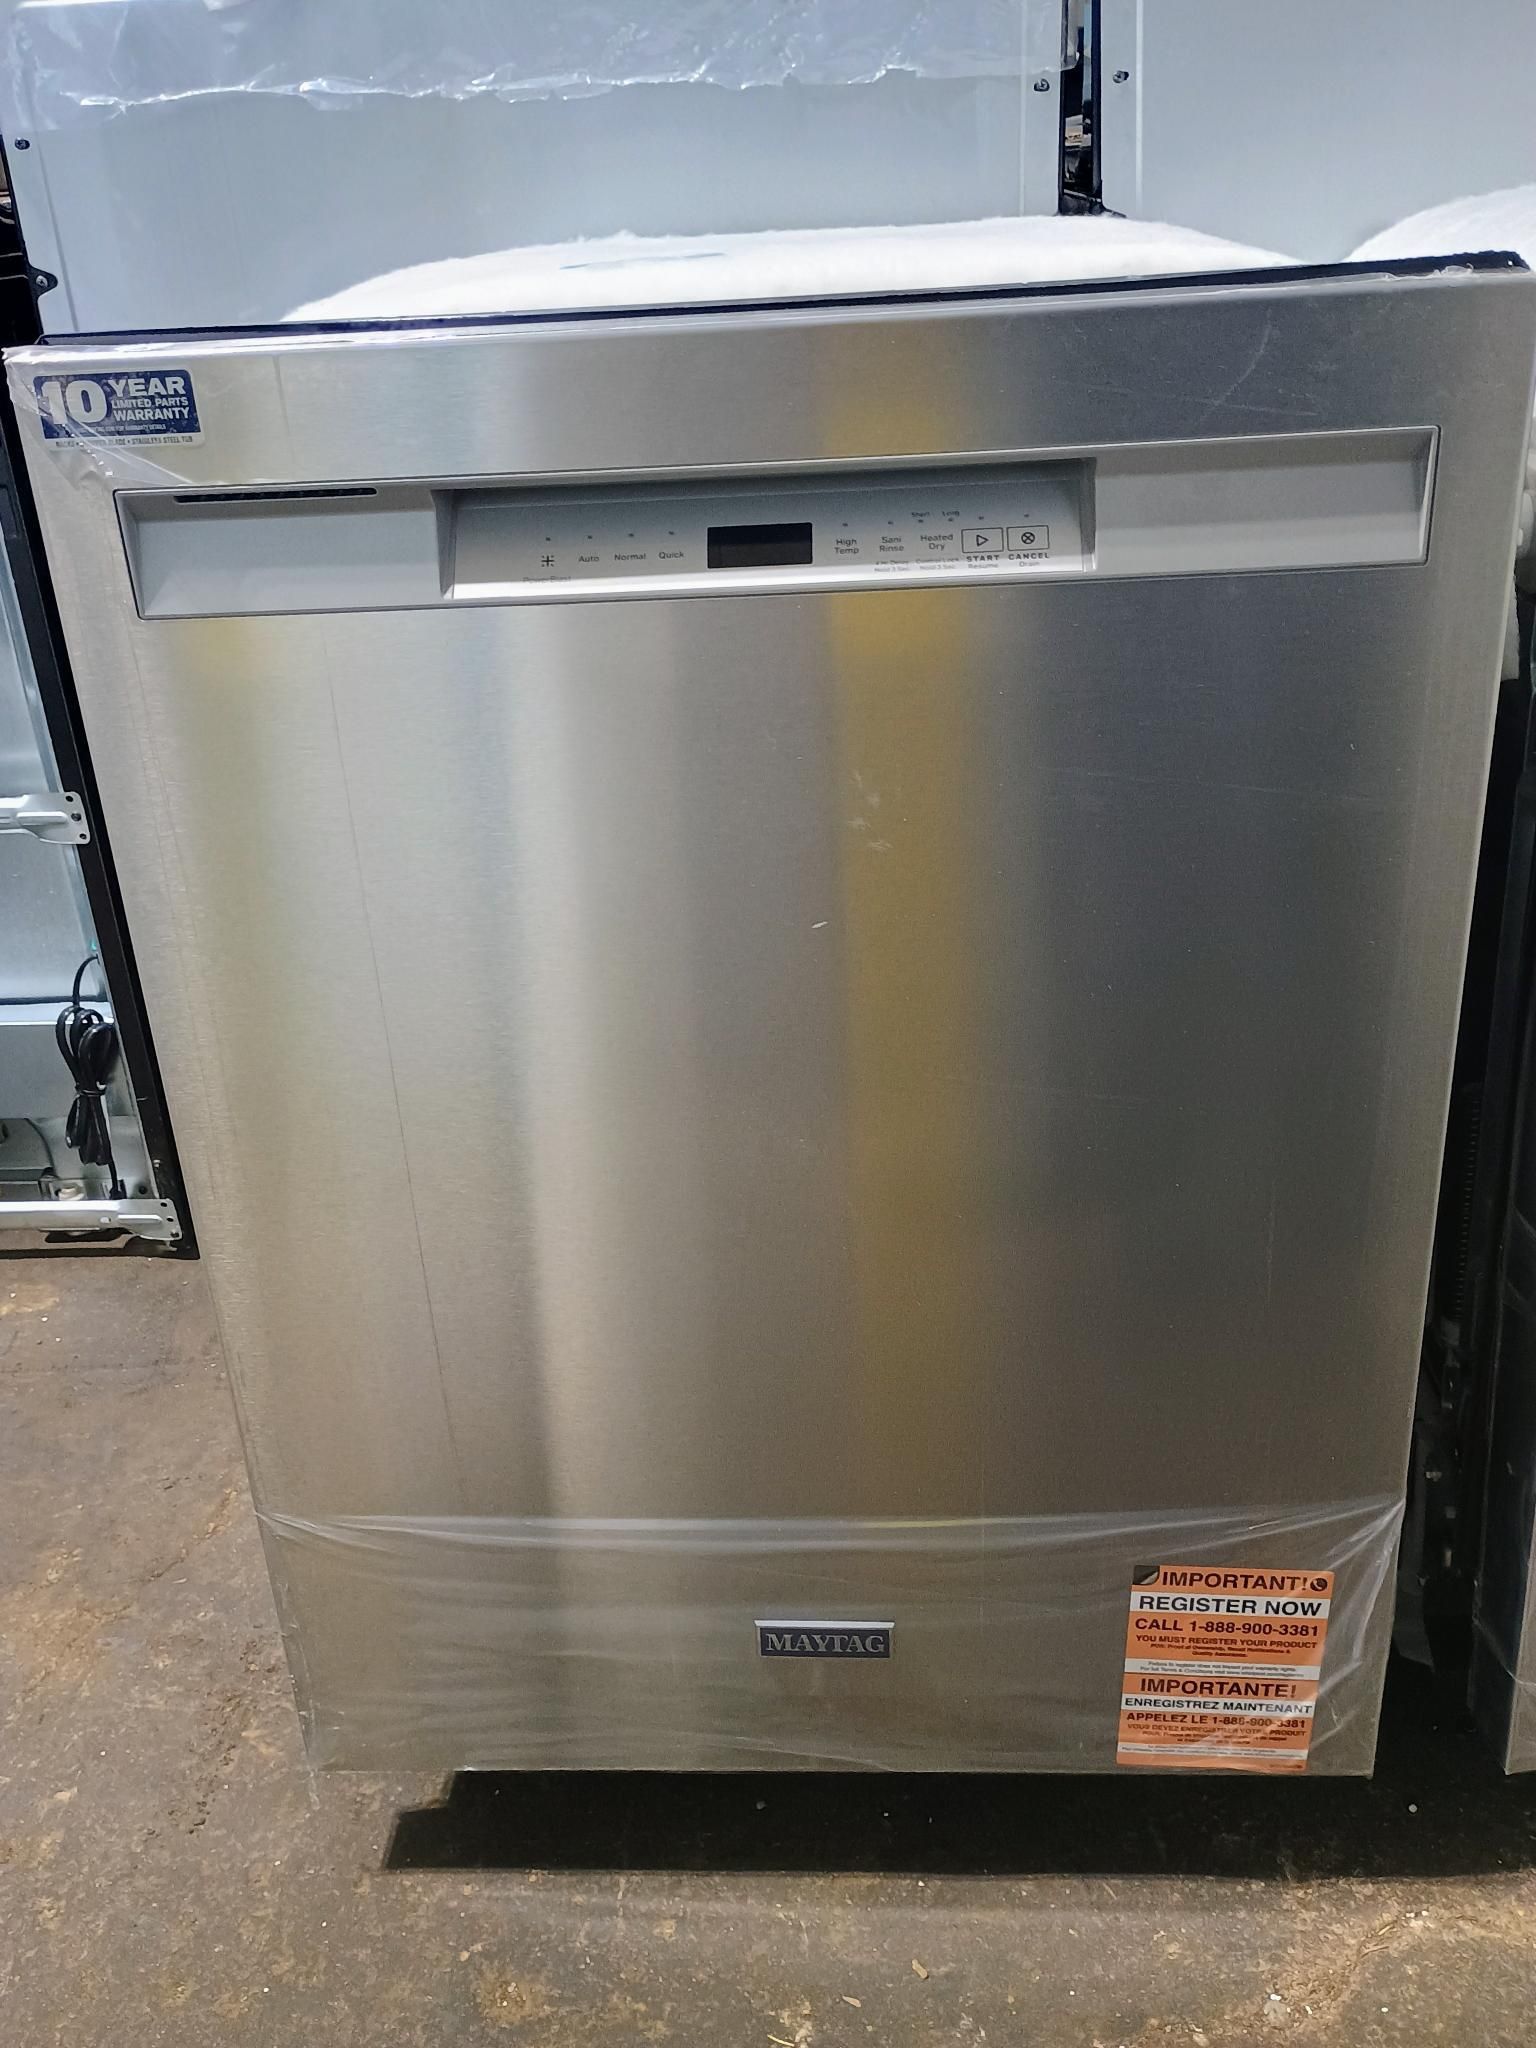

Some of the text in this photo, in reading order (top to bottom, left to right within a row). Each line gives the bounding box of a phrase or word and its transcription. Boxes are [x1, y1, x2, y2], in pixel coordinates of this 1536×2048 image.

[107, 376, 186, 398] YEAR
[41, 380, 107, 424] 10
[111, 396, 189, 409] LIMITED PARTS
[113, 406, 190, 422] WARRANTY
[836, 538, 857, 547] High
[881, 536, 902, 544] Sani
[920, 534, 953, 542] Heated
[834, 546, 859, 555] Temp
[879, 544, 904, 553] Rinse
[928, 542, 945, 551] Dry
[578, 554, 600, 563] Auto
[614, 552, 647, 562] Normal
[658, 550, 684, 560] Quick
[966, 554, 1000, 562] START
[1008, 552, 1049, 561] CANCEL
[1162, 1571, 1307, 1591] IMPORTANT!
[1139, 1595, 1322, 1616] REGISTER NOW
[1135, 1618, 1318, 1637] CALL 1-888-900-3381
[766, 1633, 885, 1653] MAYTAG
[1136, 1634, 1317, 1649] YOU MUST REGISTER YOUR PRODUCT
[1140, 1678, 1296, 1698] IMPORTANTE!
[1125, 1697, 1312, 1713] ENREGISTREZ MAINTENANT
[1126, 1712, 1188, 1723] APPELEZ
[1191, 1715, 1208, 1724] LE
